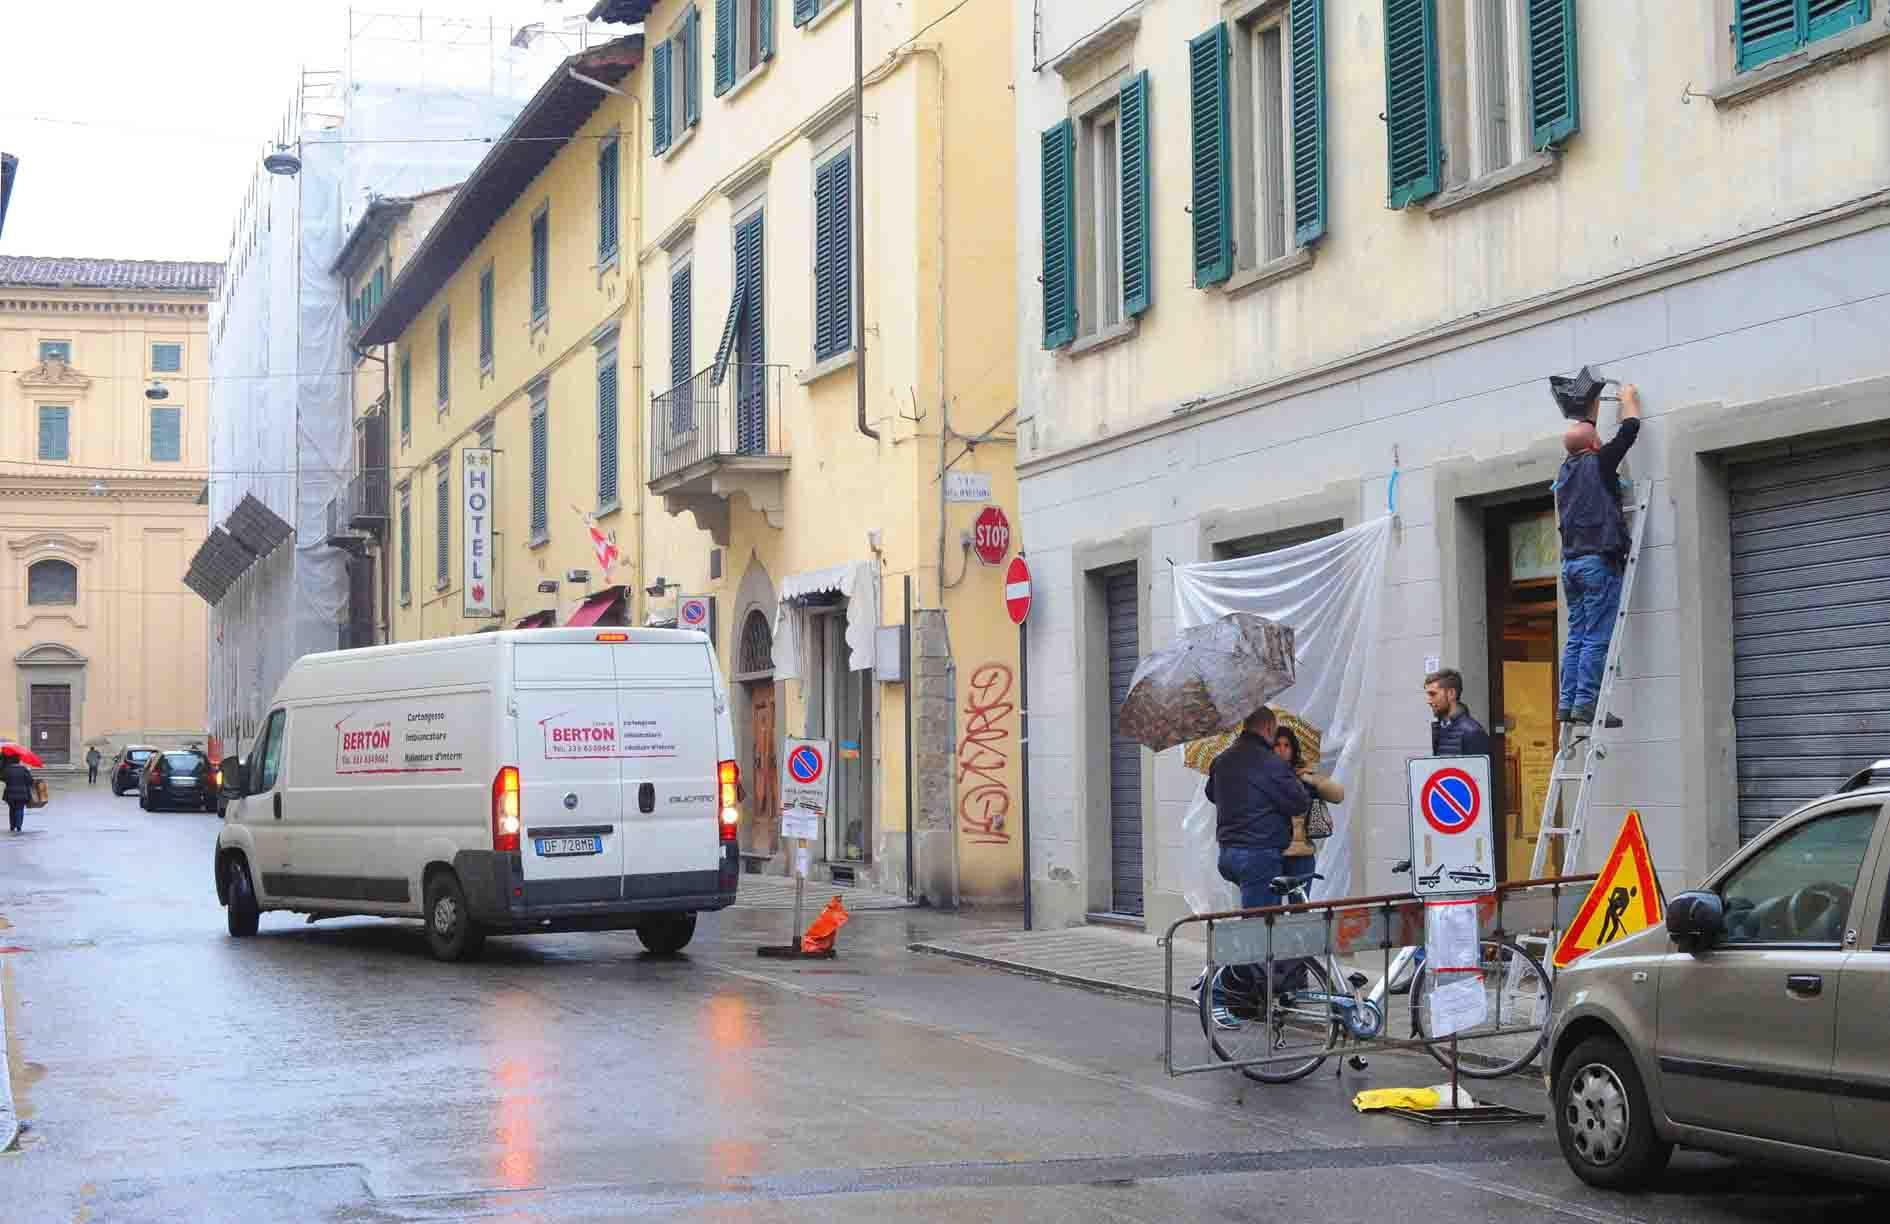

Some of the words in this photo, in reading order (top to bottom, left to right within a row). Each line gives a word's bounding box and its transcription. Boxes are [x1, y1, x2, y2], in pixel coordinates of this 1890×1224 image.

[468, 471, 487, 579] HOTEL
[977, 525, 1009, 547] STOP
[343, 730, 390, 750] BERTON
[552, 728, 615, 742] BERTON
